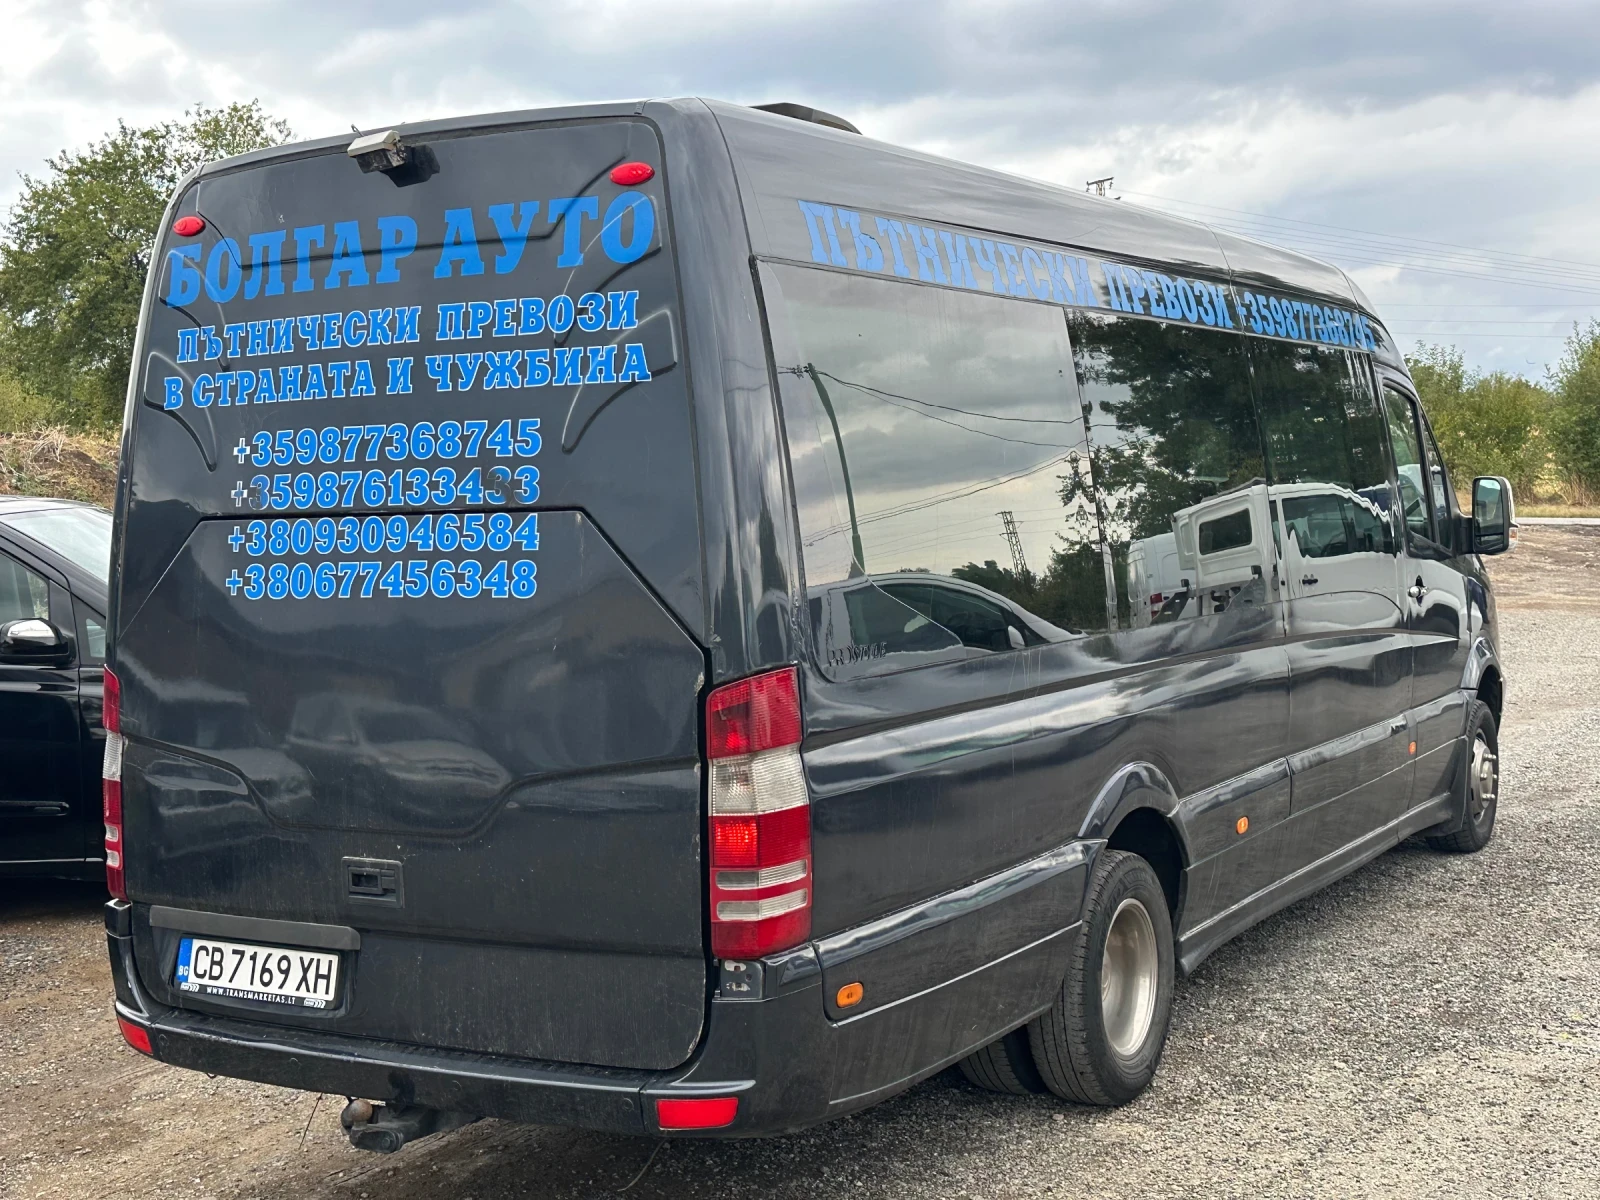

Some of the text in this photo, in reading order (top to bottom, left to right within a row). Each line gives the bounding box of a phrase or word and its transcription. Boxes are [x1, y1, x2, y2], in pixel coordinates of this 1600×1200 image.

[166, 190, 655, 308] БОЛГАР АУТО
[800, 200, 1097, 308] ПЪТНИЧЕСКИ
[1102, 262, 1233, 329] ПРЕВОЗИ
[176, 290, 639, 363] ПЪТНИЧЕСКИ ПРЕВОЗИ
[163, 343, 651, 410] В СТРАНАТА И ЧУЖБИНА
[233, 418, 542, 467] +359877368745
[231, 465, 540, 510] +359876133433
[228, 512, 539, 556] +380930946584
[225, 559, 538, 600] +380677456348
[178, 965, 189, 976] BG
